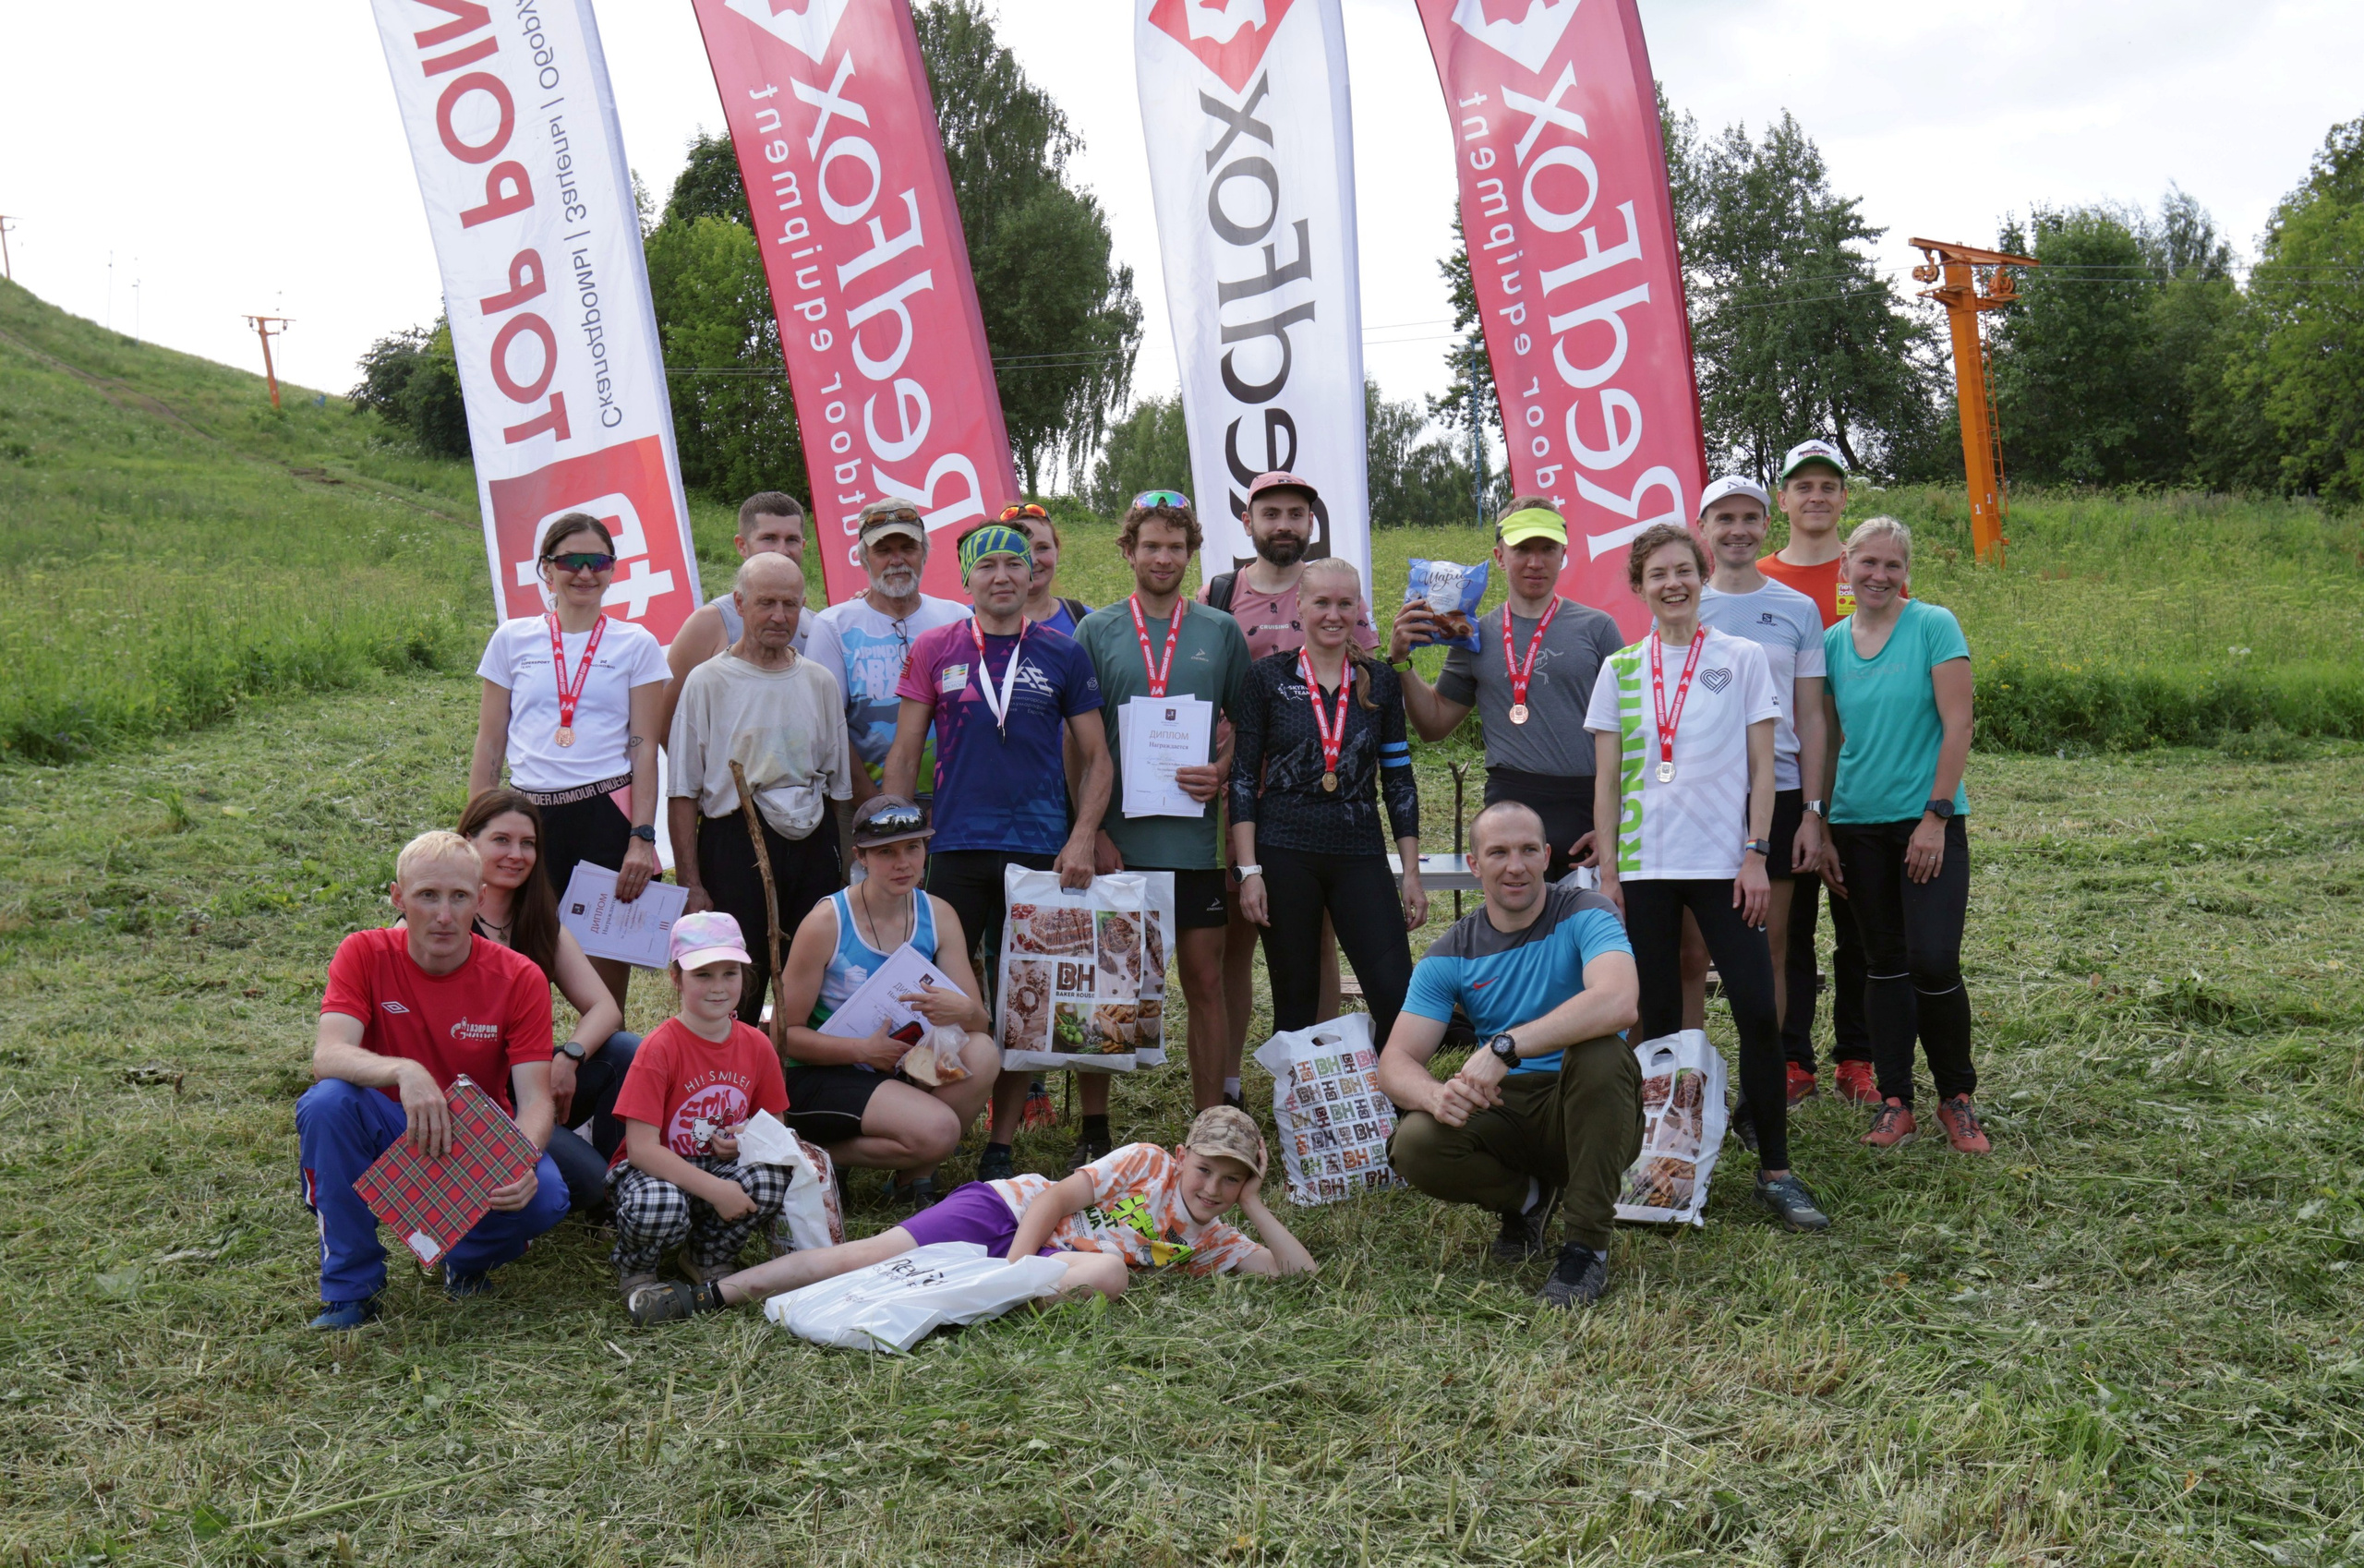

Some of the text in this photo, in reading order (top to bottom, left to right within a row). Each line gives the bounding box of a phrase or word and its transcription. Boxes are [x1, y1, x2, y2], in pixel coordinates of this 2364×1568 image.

[1975, 504, 1982, 514] 1
[1986, 493, 1992, 504] 1
[1149, 730, 1189, 741] ДИПЛОМ
[1149, 742, 1188, 750] Награждается
[687, 641, 723, 874] RUNNIN
[552, 785, 597, 805] ARMOUR
[596, 776, 627, 793] UNDER
[590, 893, 608, 935] ДИПЛОМ
[1056, 961, 1095, 992] BH
[1314, 1055, 1342, 1076] BH
[684, 1070, 751, 1093] HI! SMILE!
[1339, 1076, 1364, 1095] BH
[1296, 1083, 1323, 1104] BH
[1329, 1102, 1356, 1122] BH
[1312, 1129, 1337, 1150] BH
[1353, 1121, 1380, 1141] BH
[1644, 1117, 1658, 1144] H
[1343, 1148, 1369, 1169] BH
